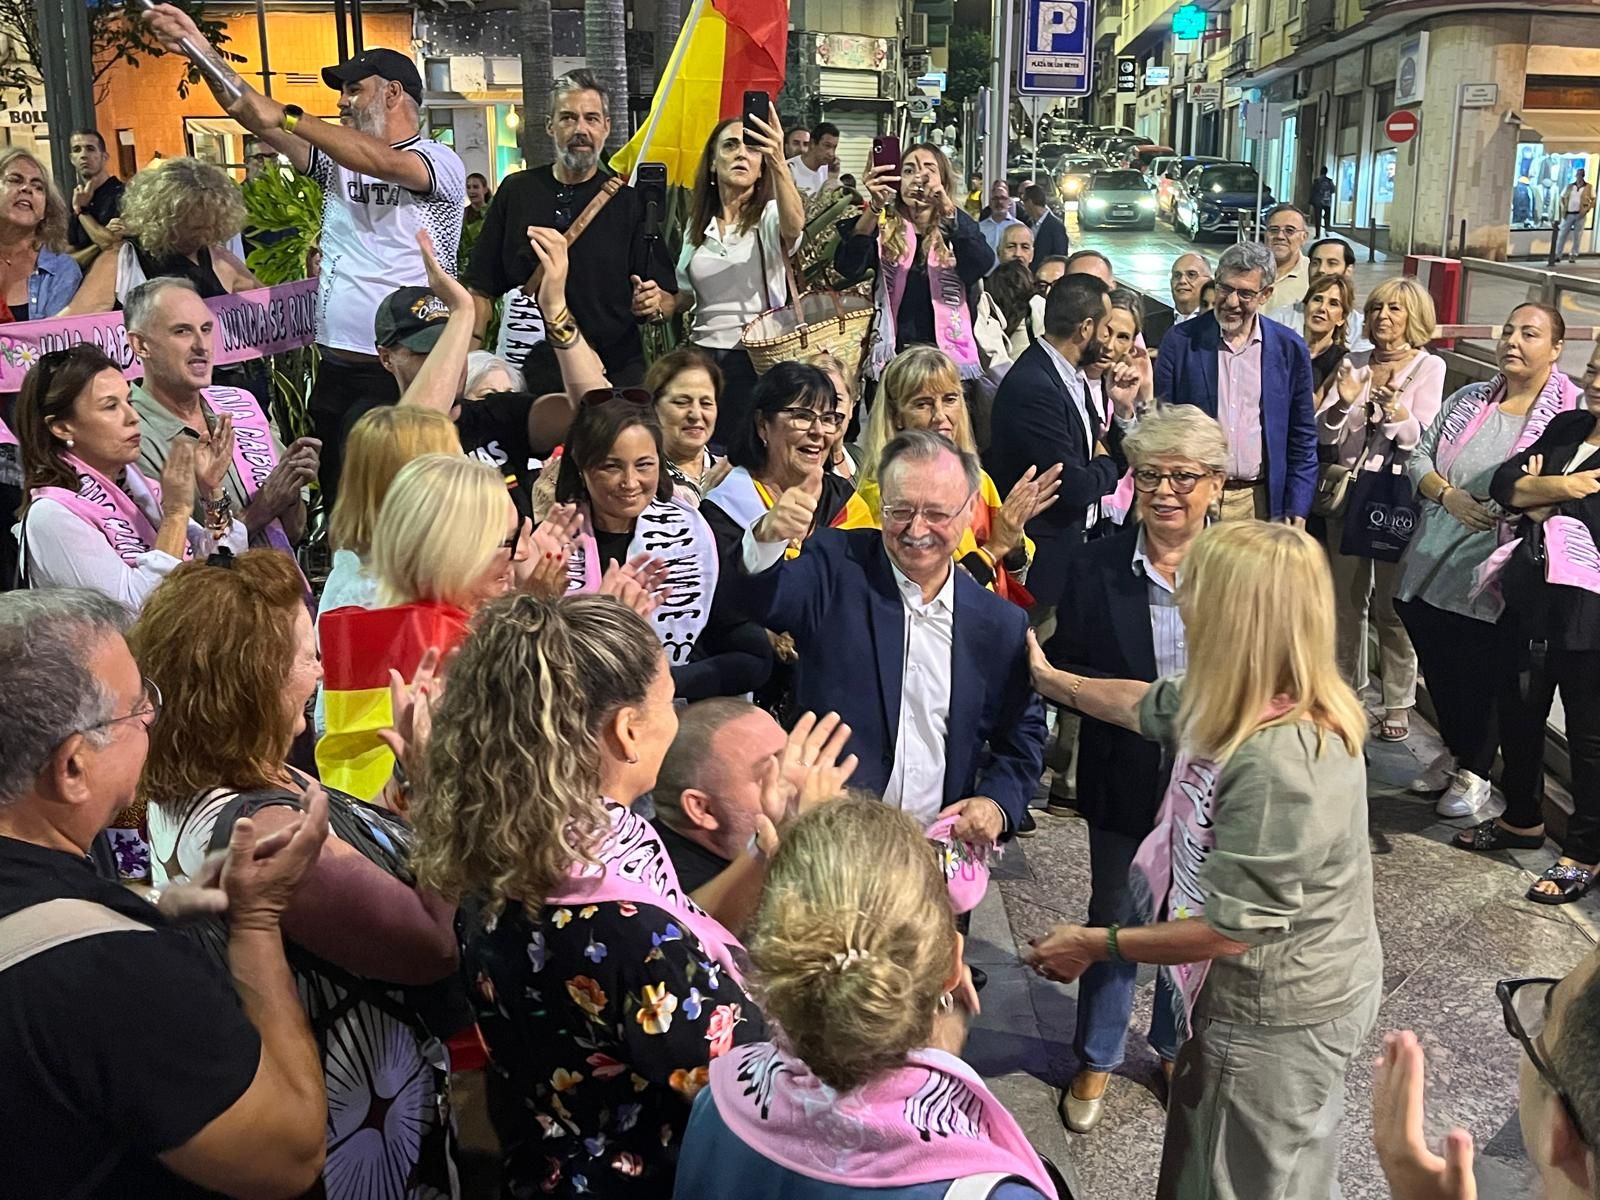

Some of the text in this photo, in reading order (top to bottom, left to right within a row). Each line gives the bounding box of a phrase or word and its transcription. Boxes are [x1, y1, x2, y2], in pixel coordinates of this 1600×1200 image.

[1037, 2, 1077, 51] P
[217, 303, 270, 352] NUNCA
[268, 298, 288, 341] SE
